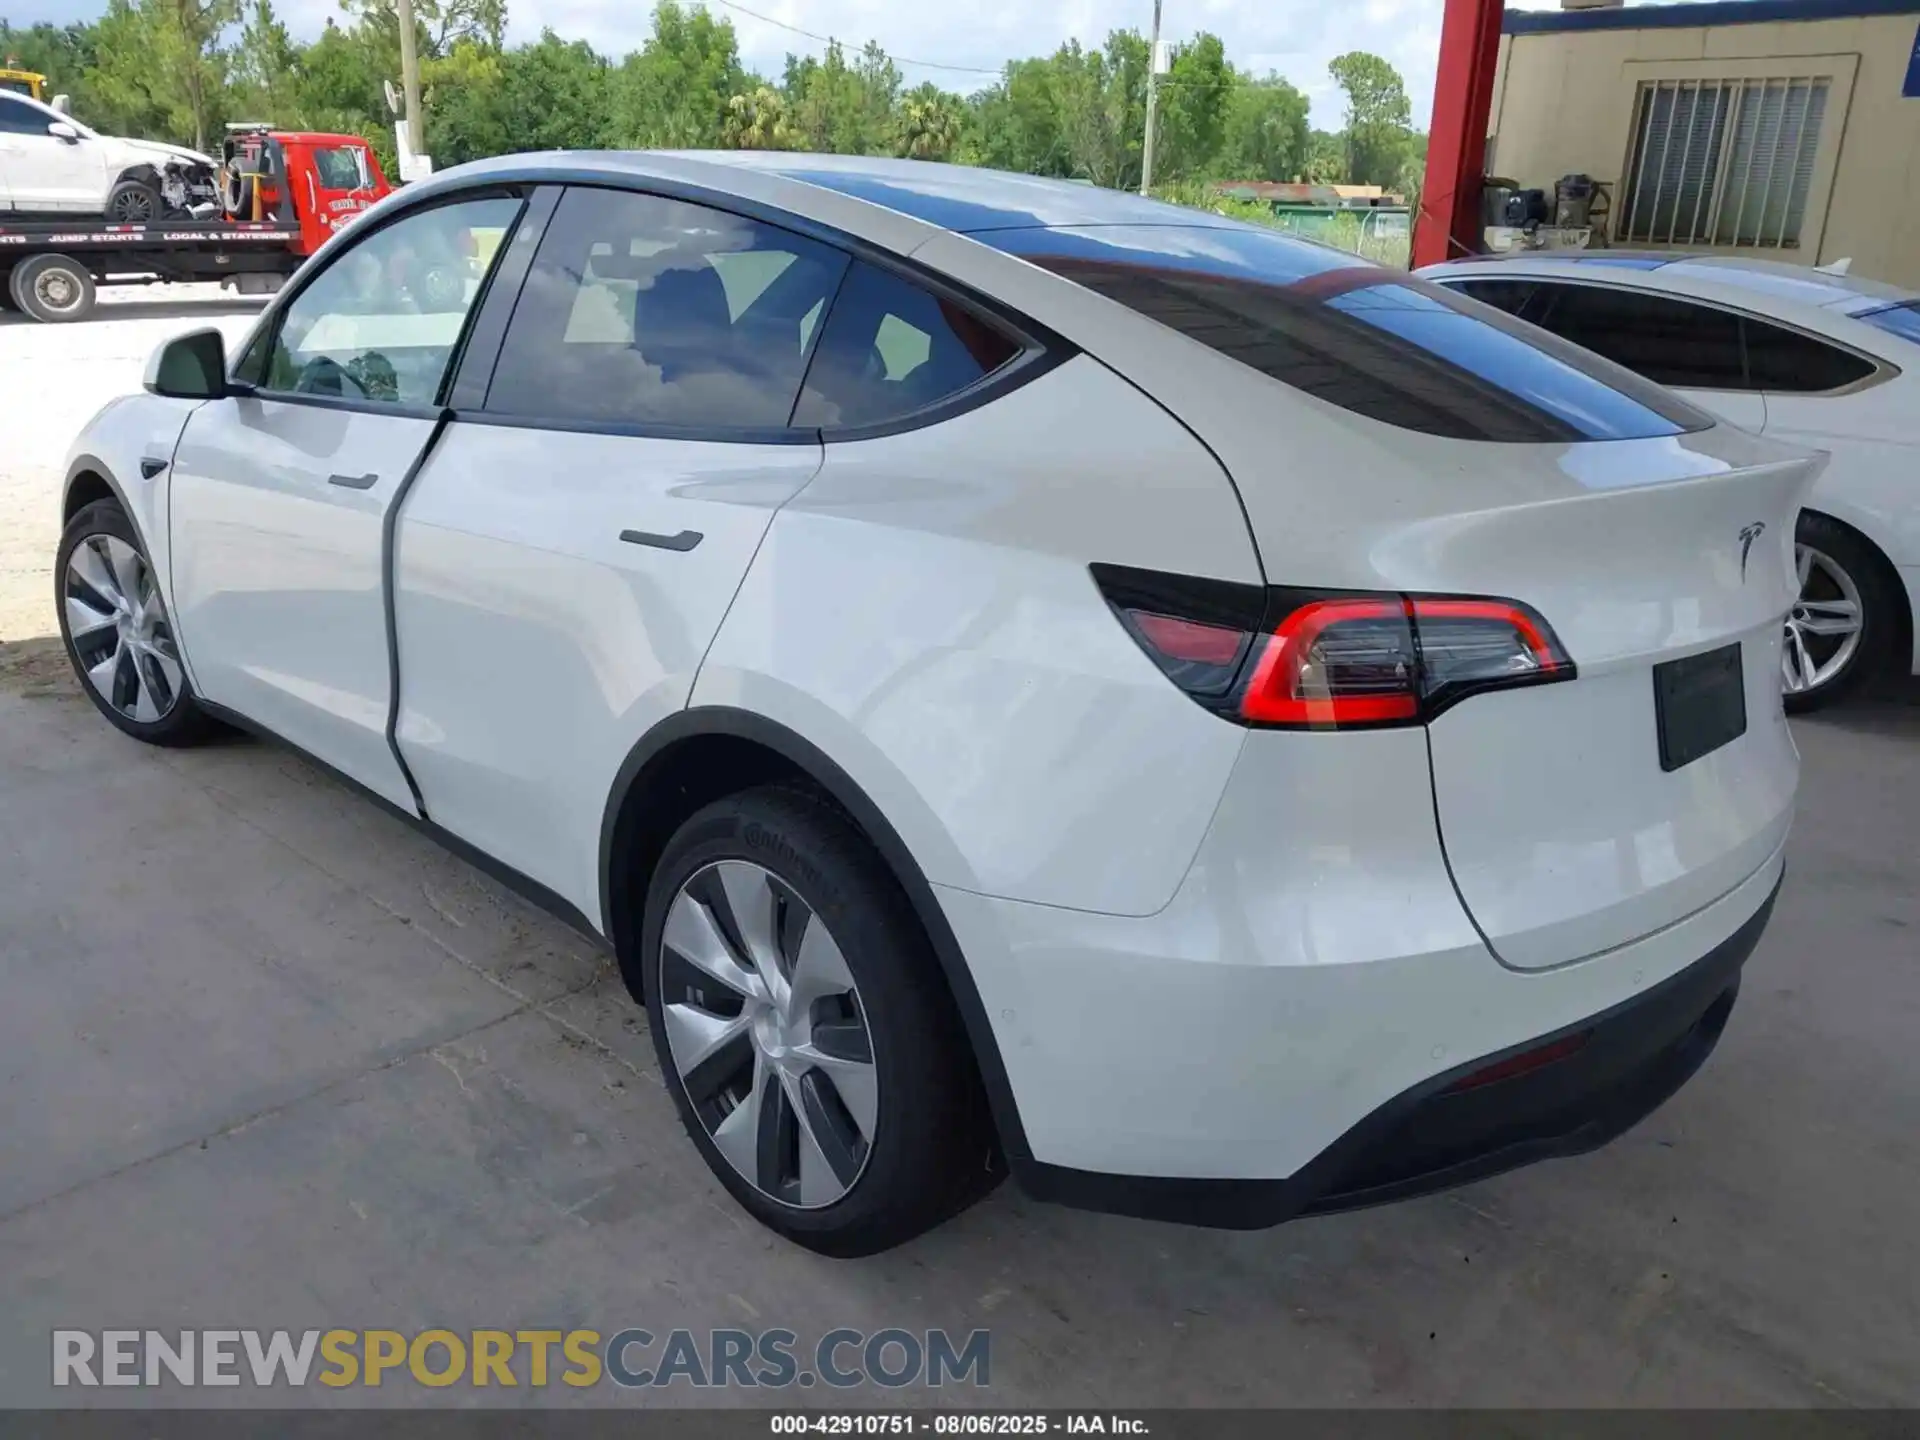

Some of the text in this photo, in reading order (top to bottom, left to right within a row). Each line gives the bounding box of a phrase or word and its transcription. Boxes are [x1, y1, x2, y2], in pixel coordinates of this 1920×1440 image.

[48, 234, 88, 242] JUMP
[91, 233, 144, 241] STARTS
[163, 232, 206, 240] LOCAL
